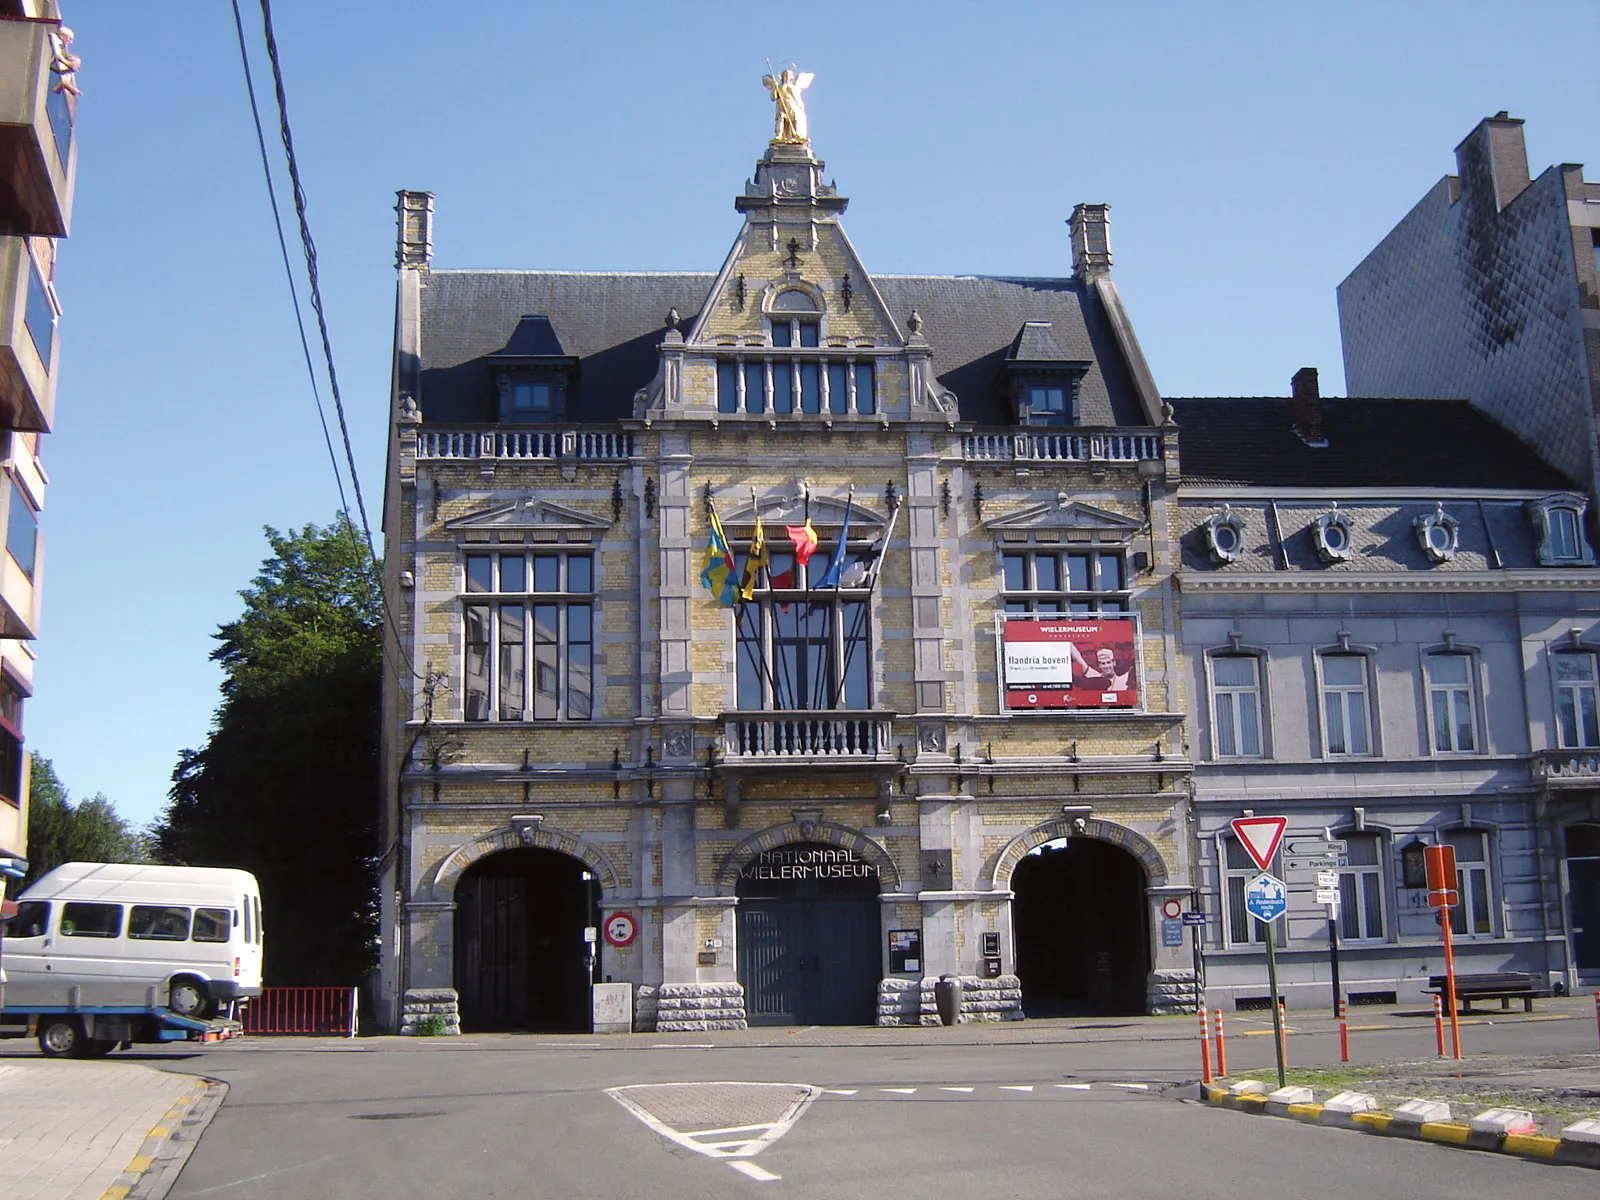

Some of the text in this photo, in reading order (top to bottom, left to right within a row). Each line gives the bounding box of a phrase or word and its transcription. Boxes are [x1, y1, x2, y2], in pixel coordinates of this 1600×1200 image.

[1008, 656, 1069, 665] flandria boven!
[1327, 843, 1342, 851] Ring
[760, 849, 859, 864] NATIONAAL
[1308, 860, 1337, 868] Parkings
[739, 864, 880, 880] WIELERMUSEUM
